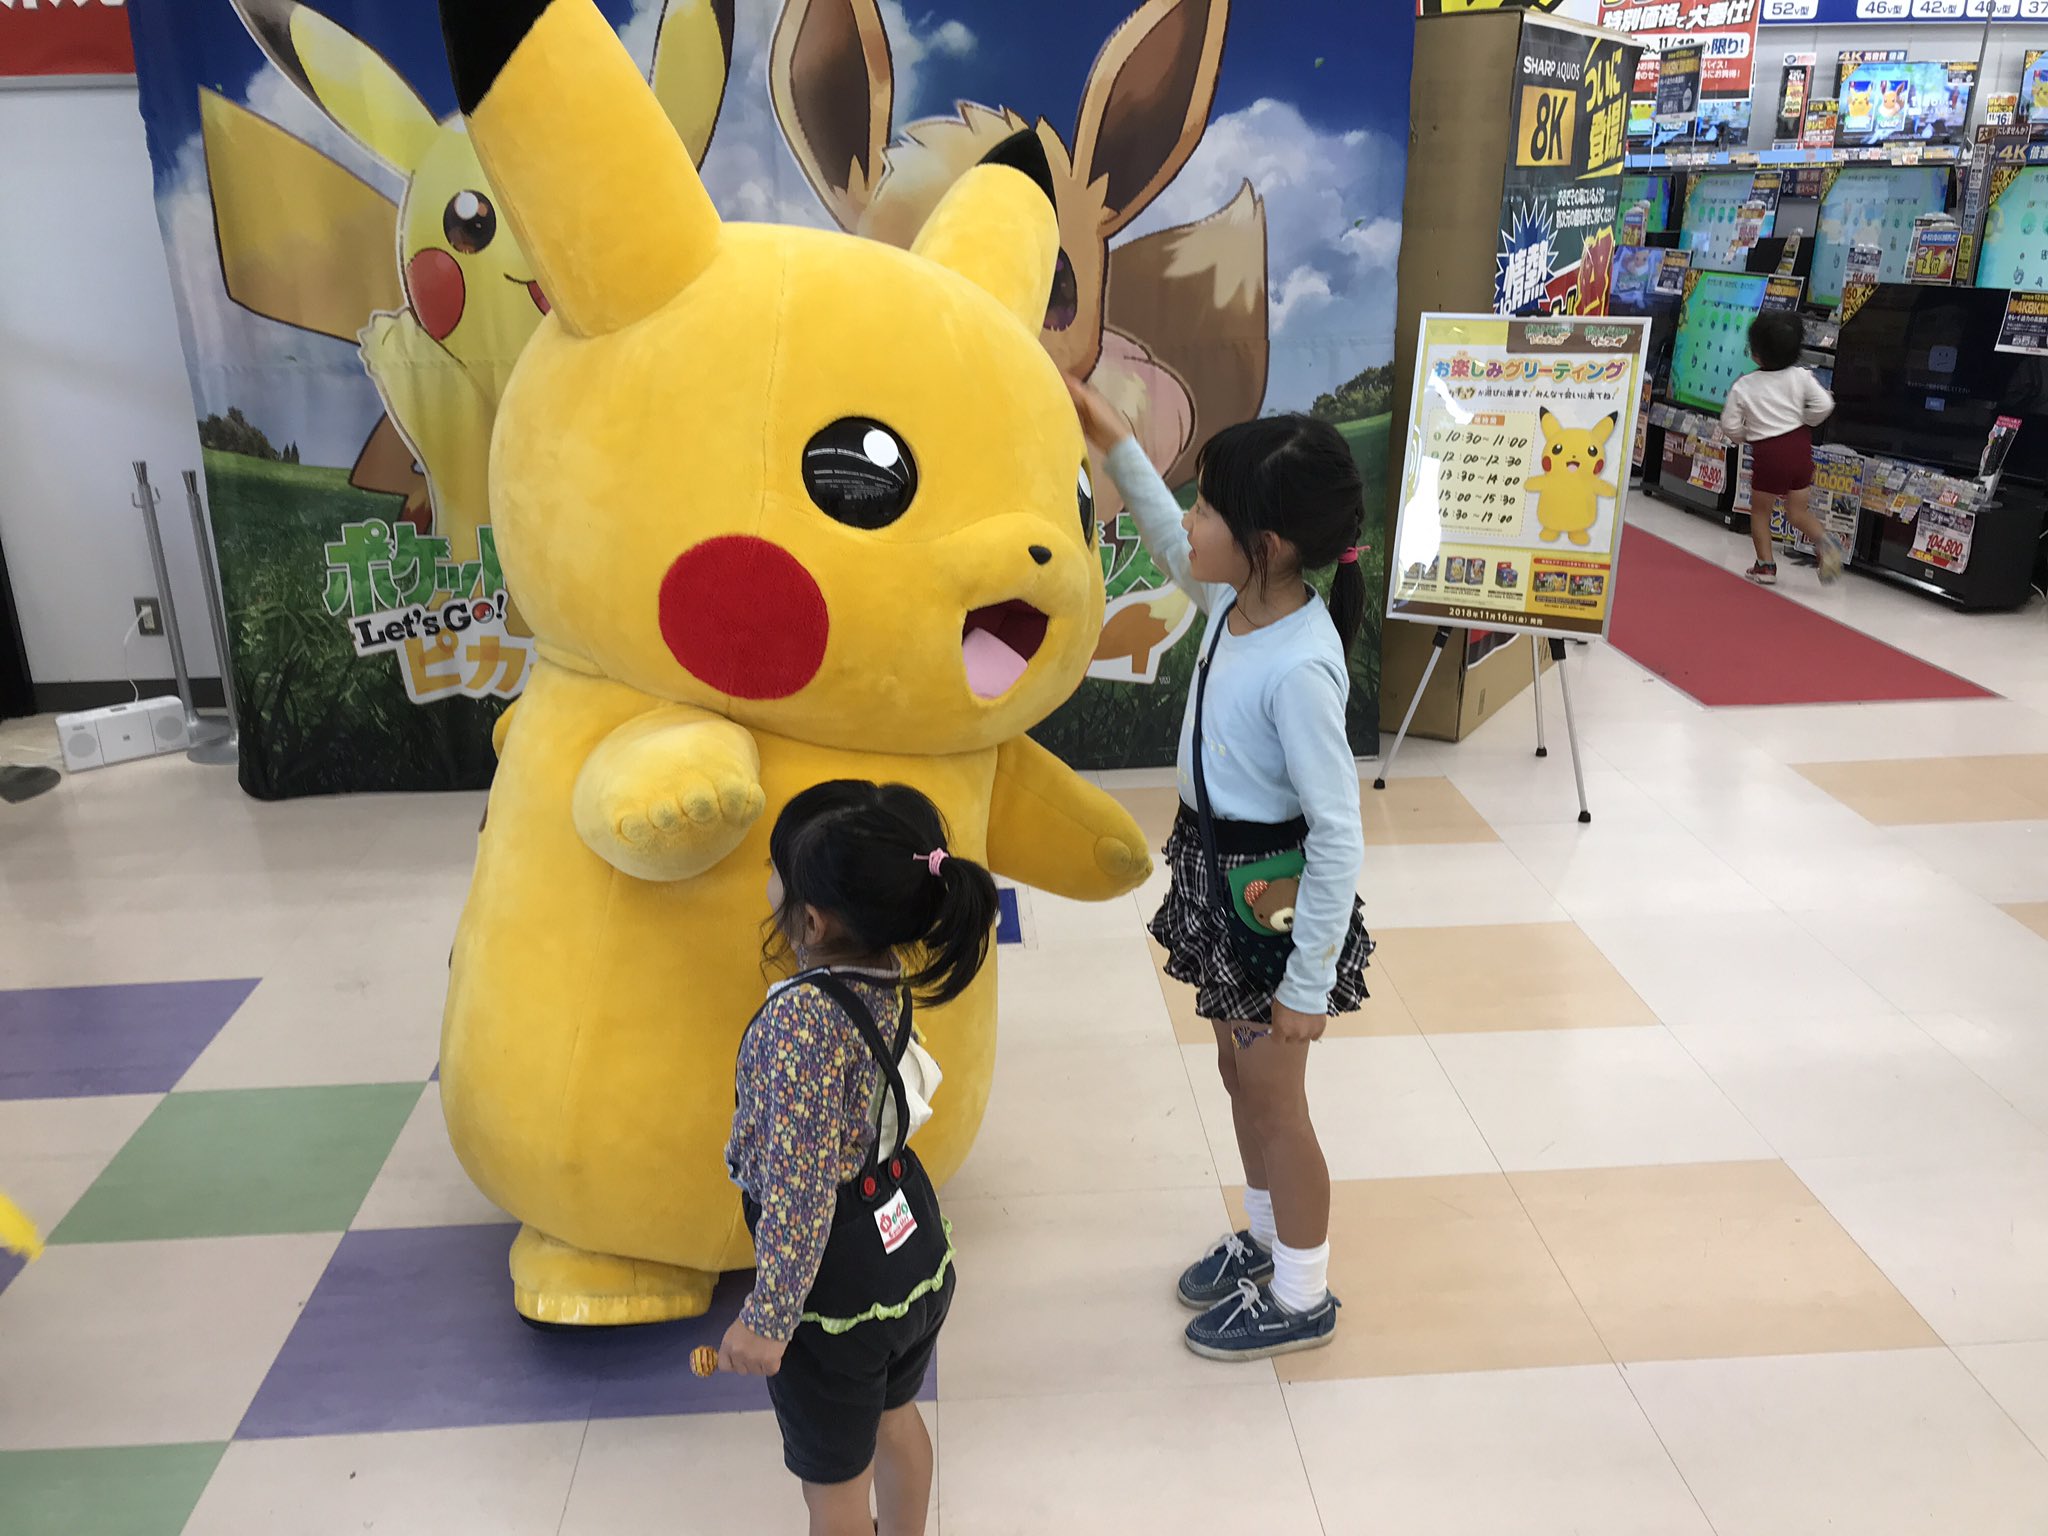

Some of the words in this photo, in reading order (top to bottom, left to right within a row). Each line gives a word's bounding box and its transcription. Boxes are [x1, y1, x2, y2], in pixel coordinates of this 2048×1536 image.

[1523, 55, 1556, 77] SHARP
[1556, 61, 1580, 81] AQUOS
[1584, 47, 1623, 112] ついに
[1530, 92, 1569, 162] 8K
[1998, 144, 2030, 160] 4K
[1434, 358, 1626, 382] お楽しみグリーティング
[354, 609, 441, 649] Let's
[403, 627, 533, 697] ピカ
